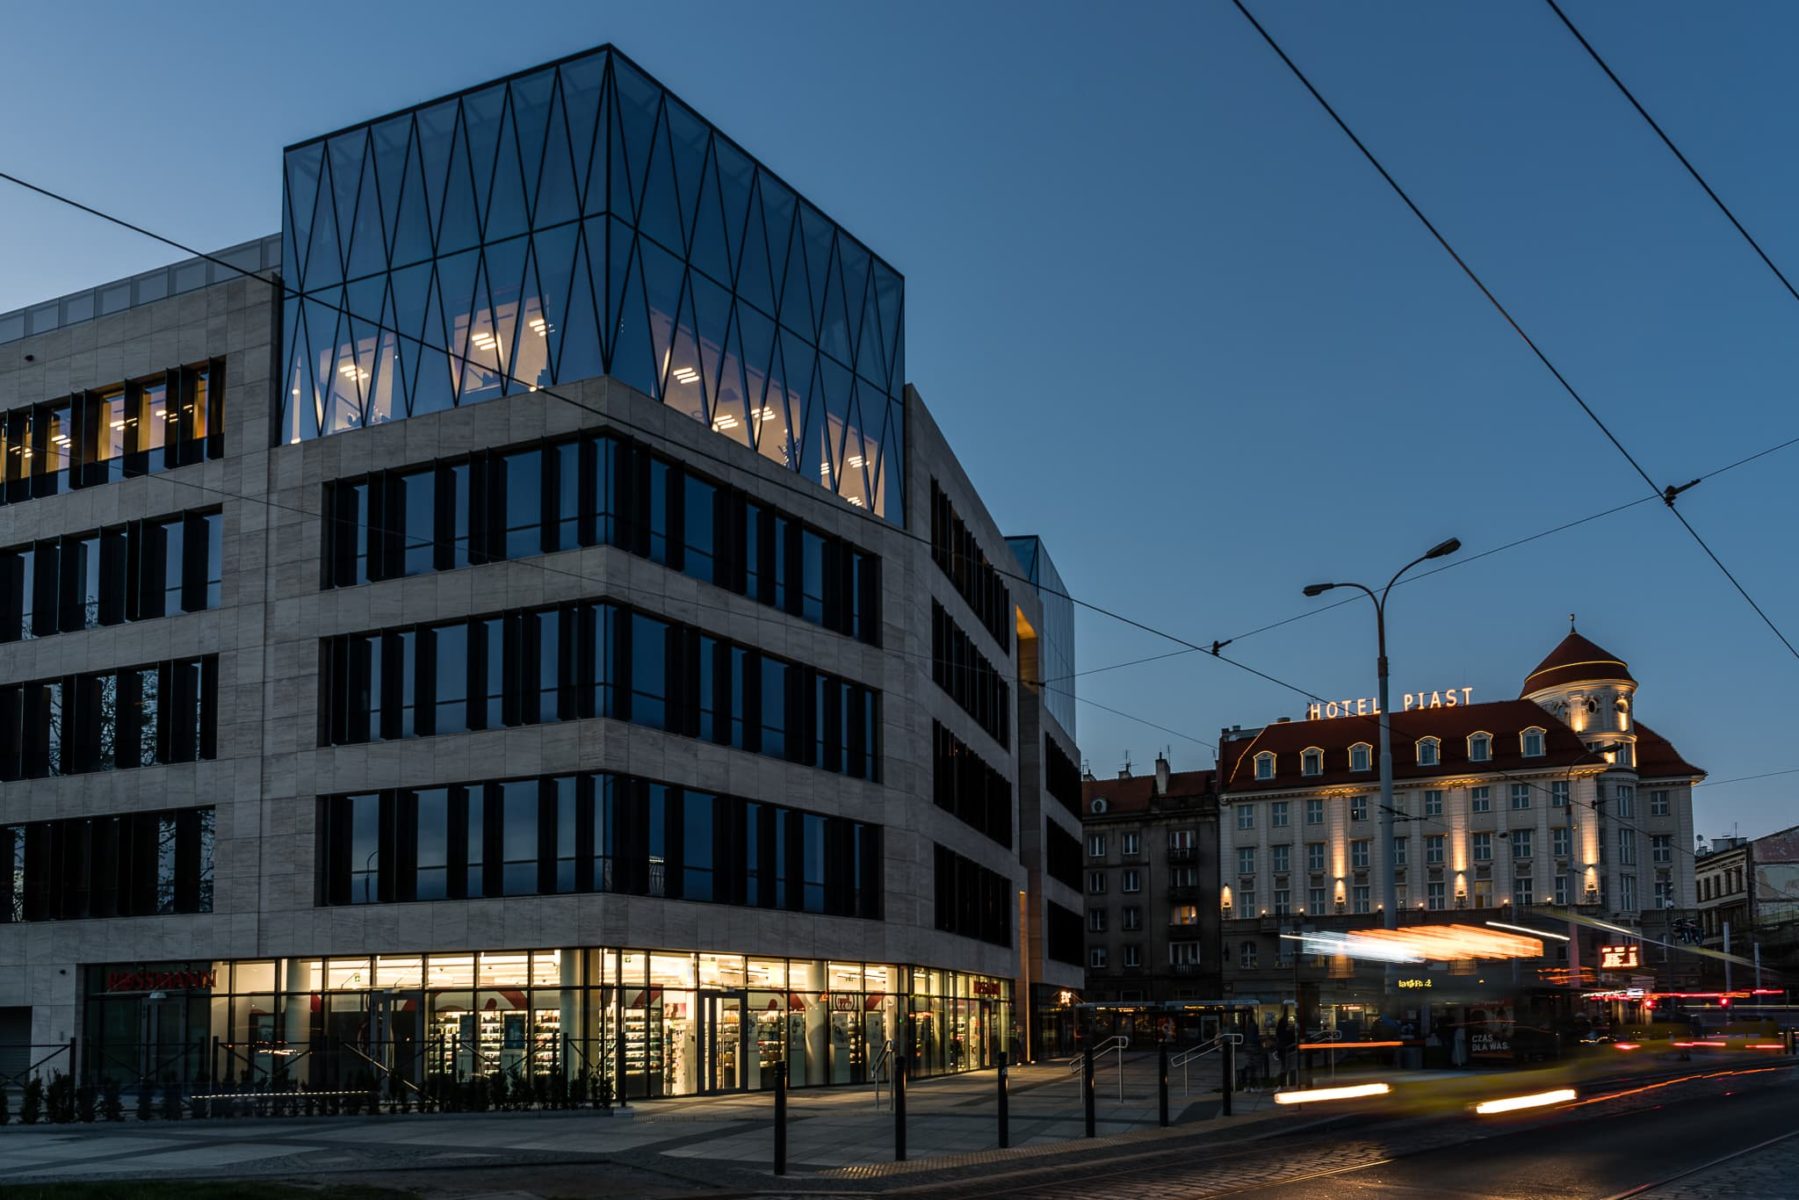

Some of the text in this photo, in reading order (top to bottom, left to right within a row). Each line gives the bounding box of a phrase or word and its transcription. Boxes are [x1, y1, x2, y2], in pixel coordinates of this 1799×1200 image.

[1310, 687, 1473, 720] HOTEL PIAST
[1472, 1033, 1493, 1043] CZAS
[1472, 1042, 1488, 1051] DLA
